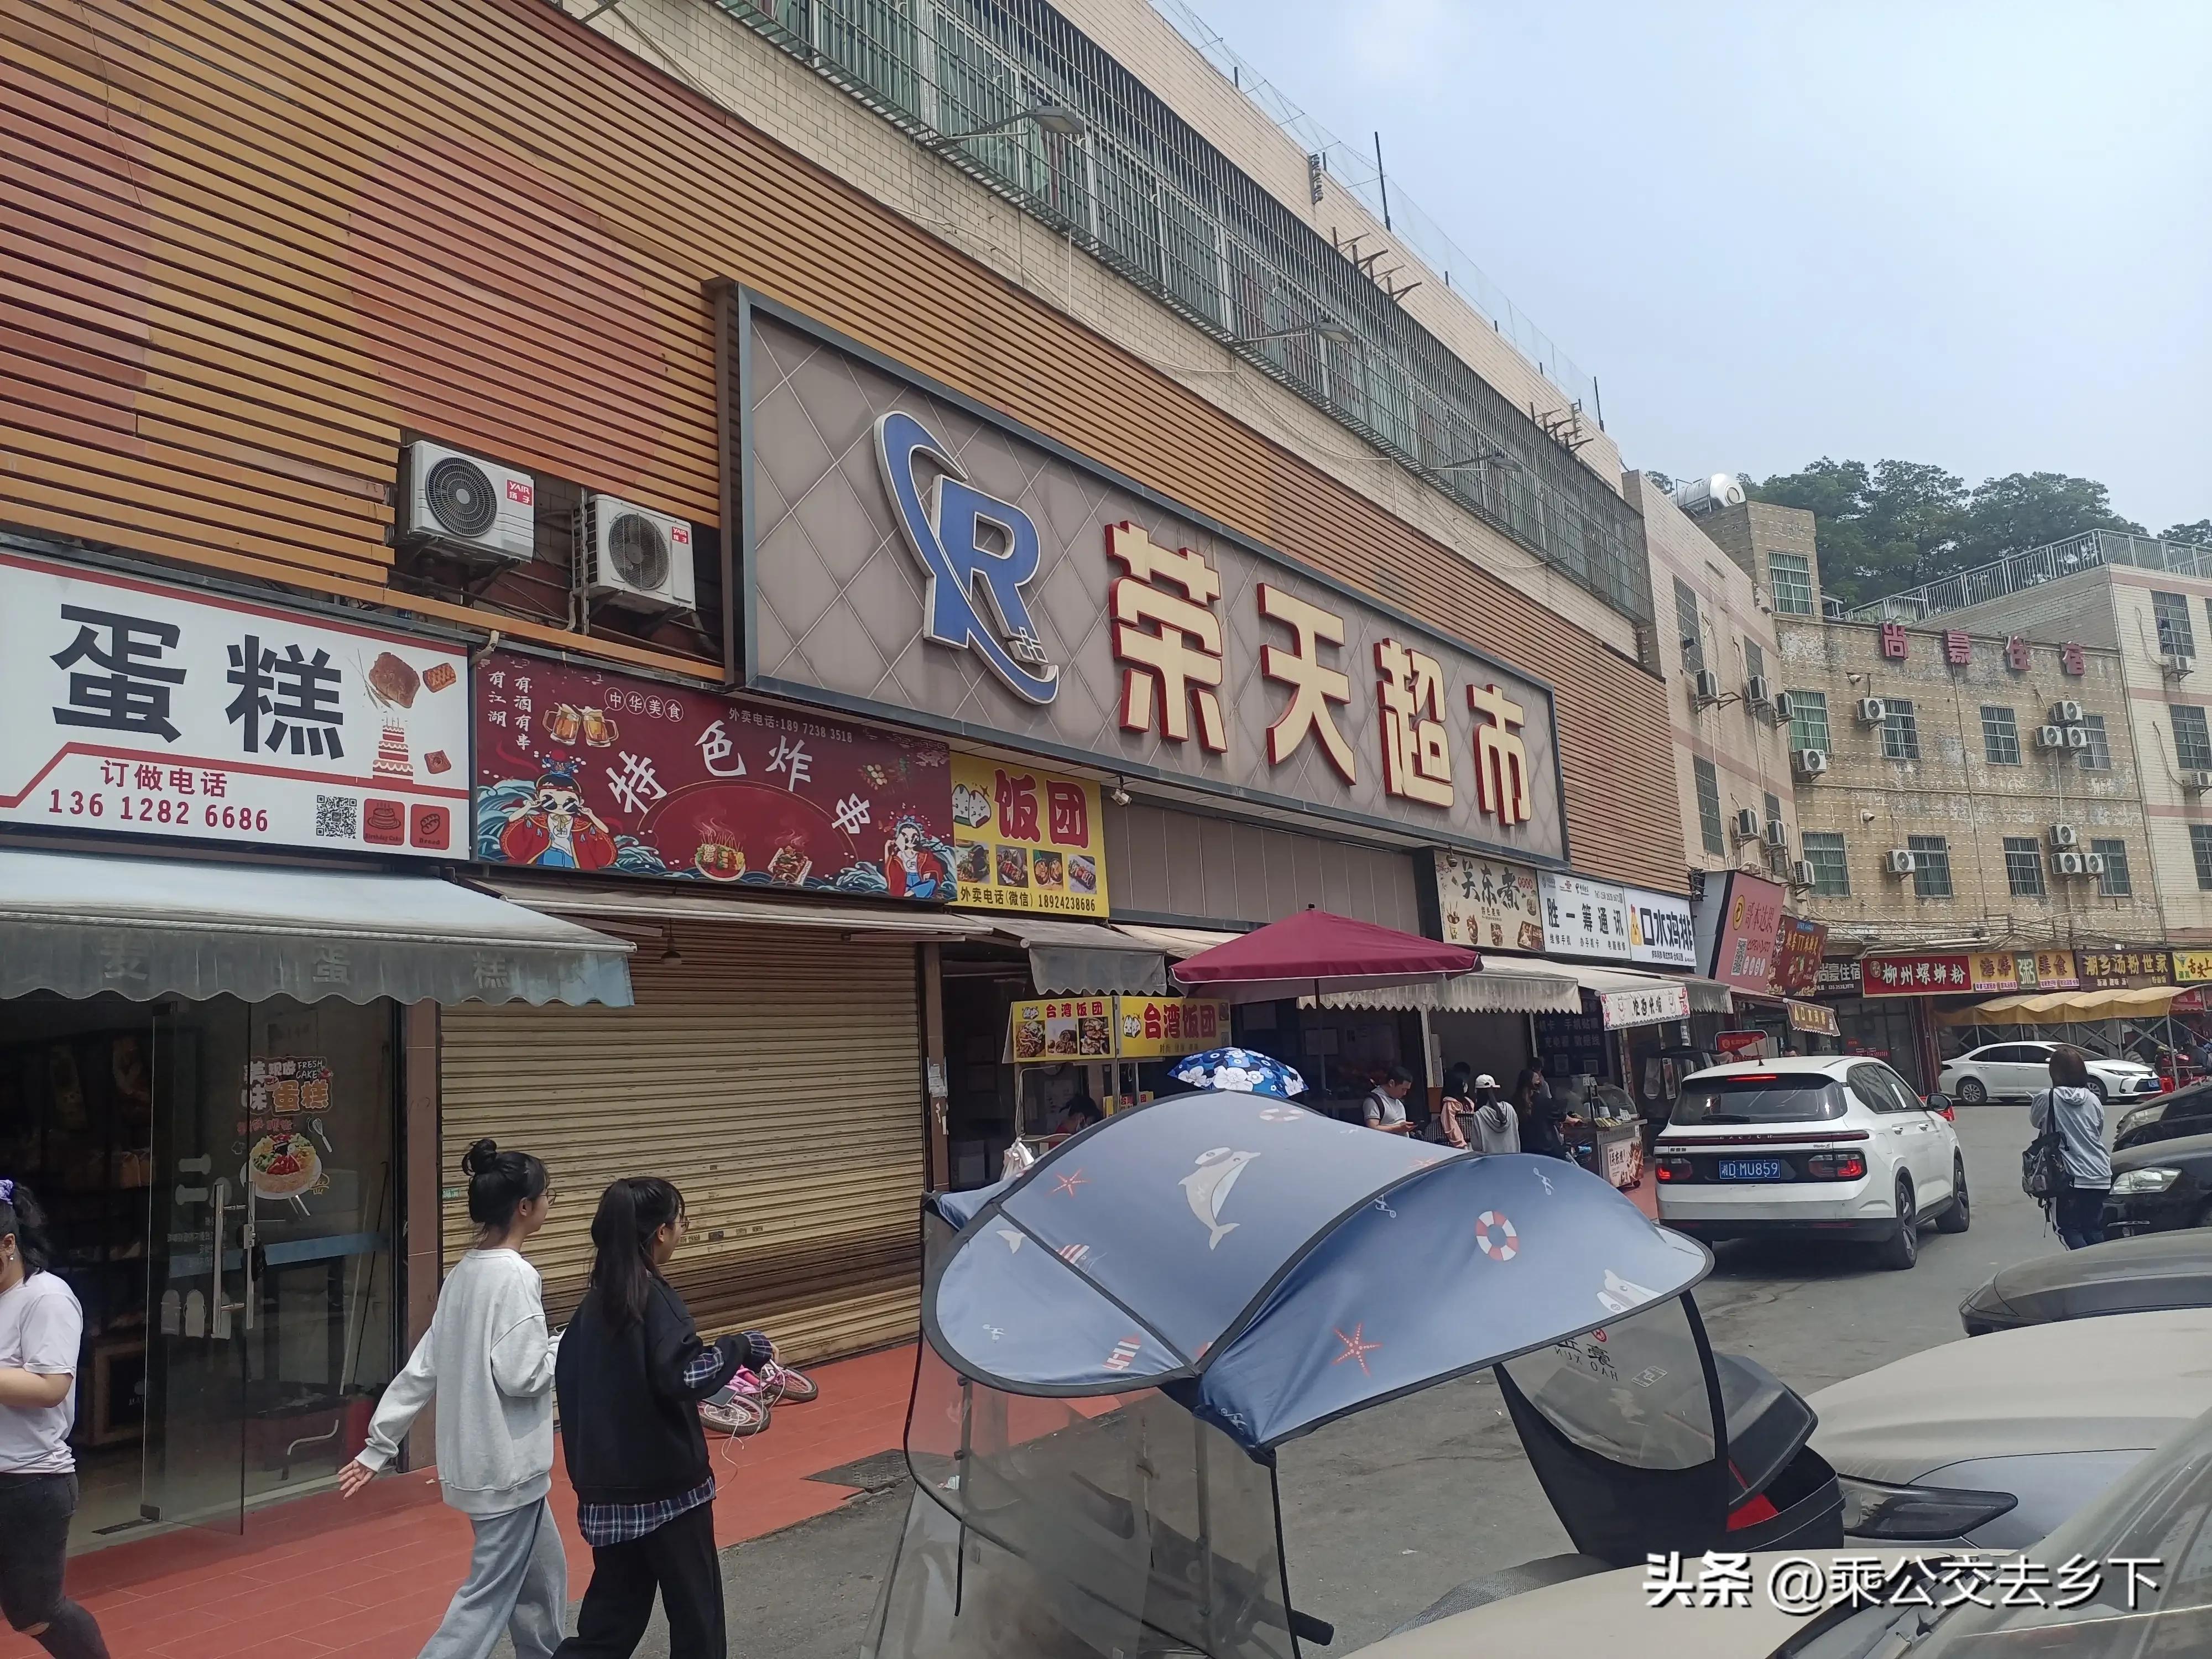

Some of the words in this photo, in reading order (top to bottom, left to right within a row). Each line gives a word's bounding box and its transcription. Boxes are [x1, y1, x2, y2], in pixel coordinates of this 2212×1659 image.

[509, 481, 531, 494] YAIR
[672, 527, 687, 537] YAIR
[50, 603, 345, 759] 蛋糕
[1105, 520, 1531, 826] 荣天超市
[488, 671, 507, 727] 有江湖
[514, 676, 532, 750] 有酒有串
[608, 691, 682, 719] 中华美食
[803, 721, 826, 738] 7238
[830, 727, 852, 743] 3518
[100, 759, 227, 797] 订做电话
[606, 719, 870, 834] 特色炸串
[49, 789, 103, 816] 136
[120, 796, 190, 826] 1282
[205, 806, 268, 832] 6686
[994, 768, 1091, 849] 饭团
[1462, 858, 1520, 910] 关东煮
[1039, 896, 1095, 911] 18924238686
[1547, 898, 1624, 936] 胜一筹通讯
[1640, 907, 1693, 951] 口水鸡排
[1882, 962, 1966, 987] 柳州螺蛳粉
[2083, 953, 2168, 975] 潮乡汤粉世家
[1046, 1001, 1103, 1019] 台湾饭团
[1144, 1003, 1216, 1040] 台湾饭团
[296, 1071, 317, 1079] CAKE
[298, 1060, 322, 1070] FRESH
[273, 1079, 328, 1112] 蛋糕
